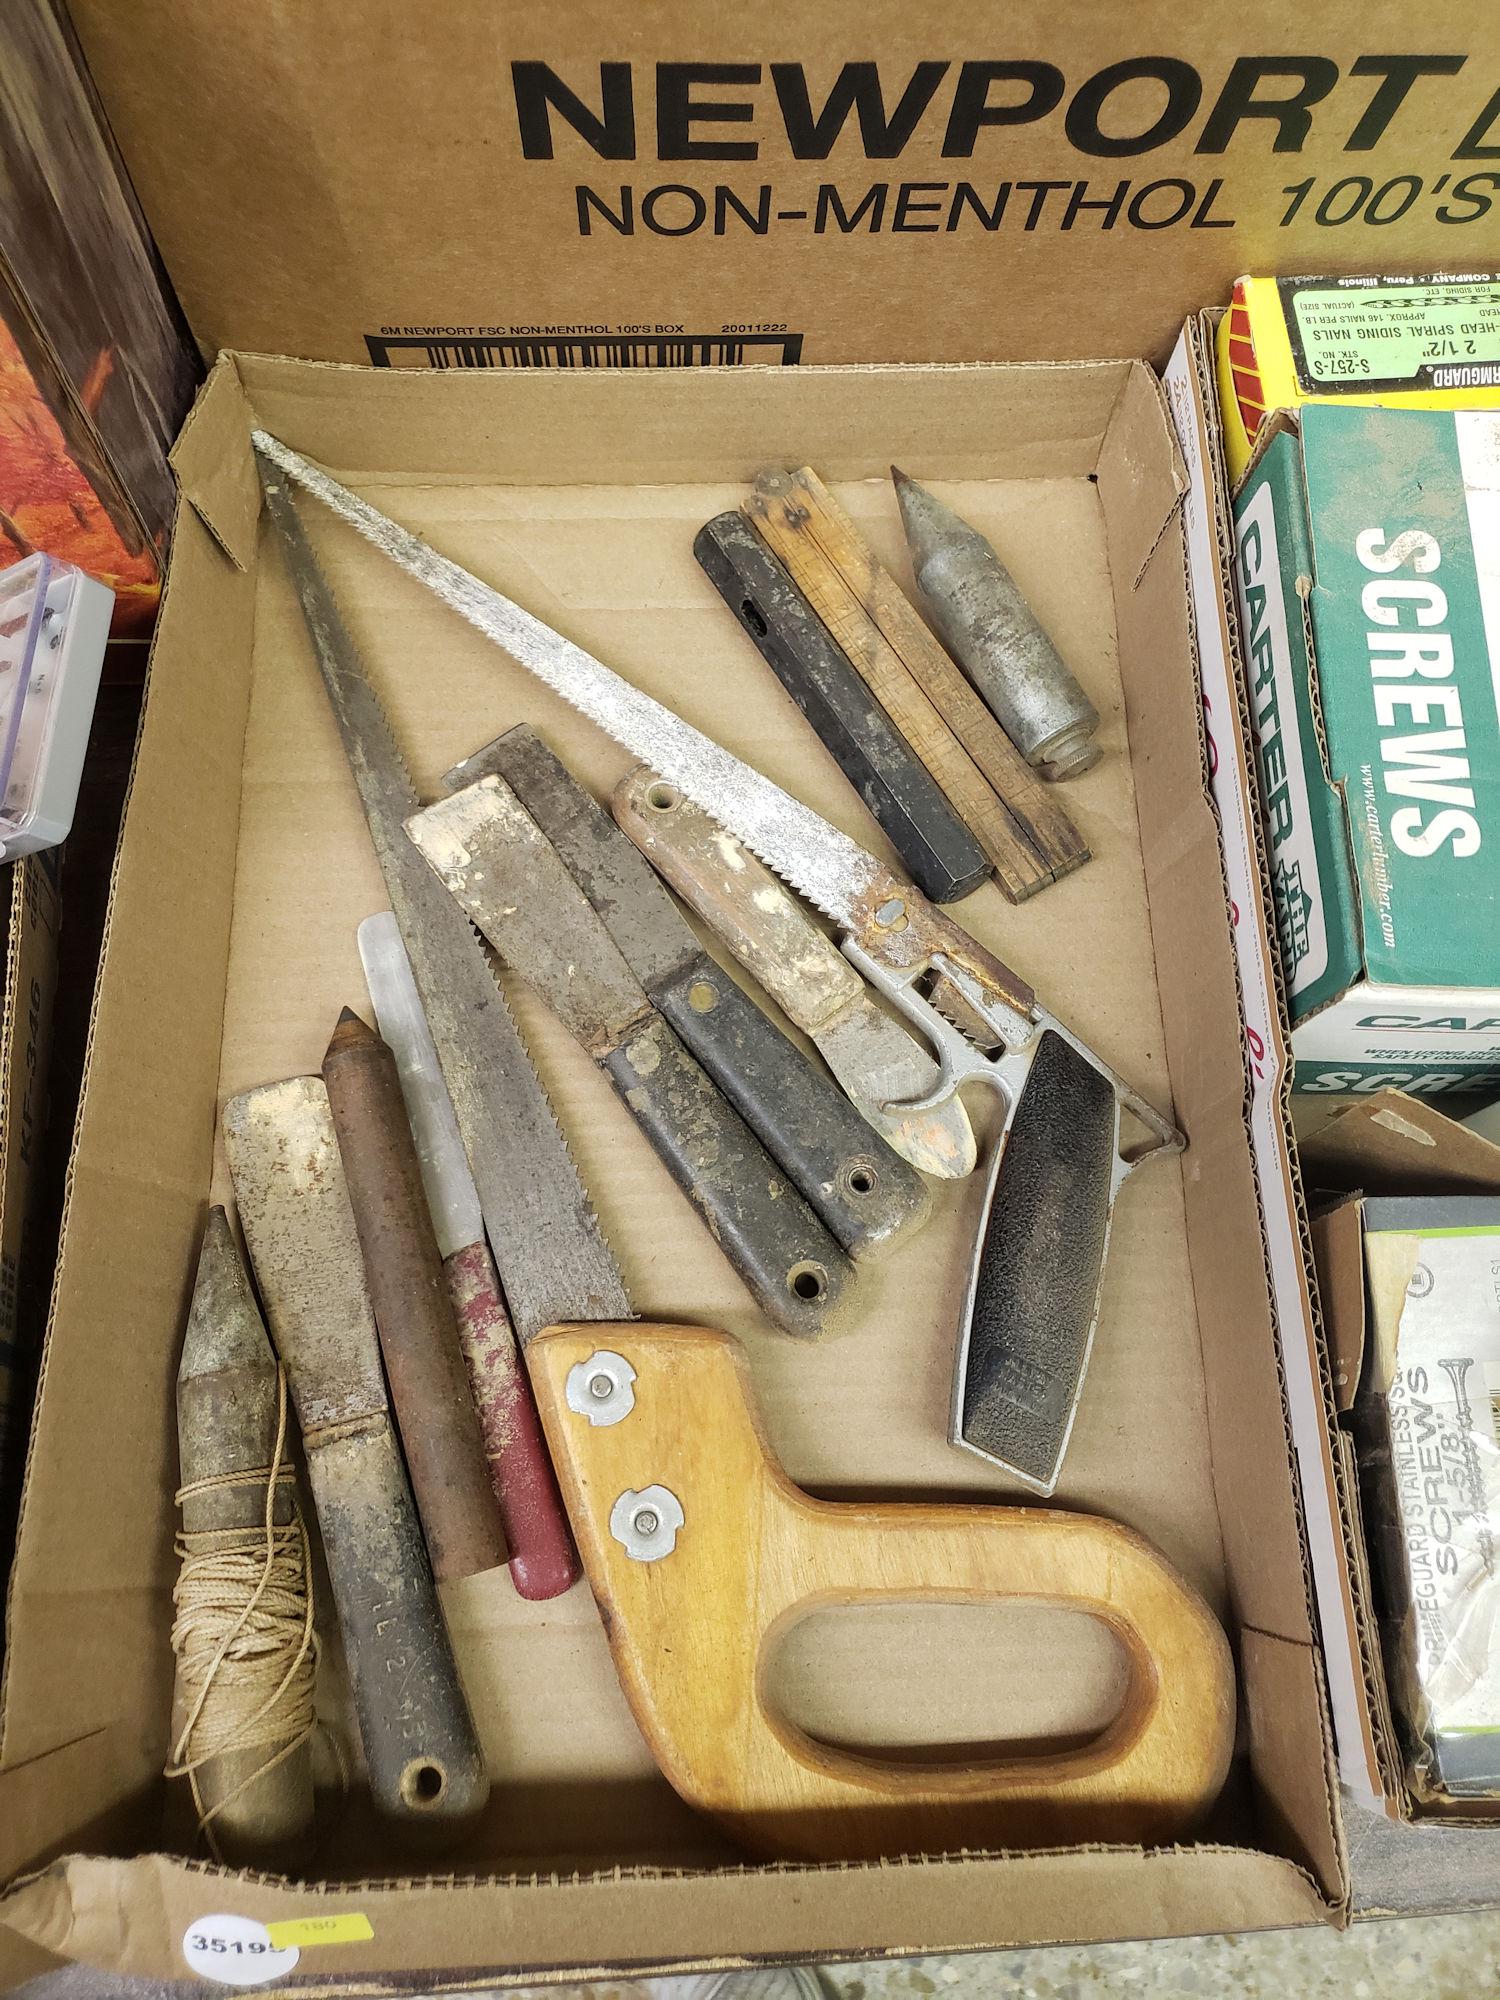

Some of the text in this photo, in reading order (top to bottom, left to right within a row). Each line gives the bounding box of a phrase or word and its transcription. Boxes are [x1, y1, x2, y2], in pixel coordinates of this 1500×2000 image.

[510, 55, 1468, 161] NEWPORT
[576, 172, 1500, 237] NON-MENTHOL 100'S
[1337, 275, 1379, 287] Illinois
[1300, 301, 1355, 311] (ACTUAL SIZE)
[1302, 312, 1426, 324] APPROX. 146 NAILS PER LB.
[380, 323, 789, 336] 6M NEWPORT FSC NON-MENTHOL 100'S BOX 20011222
[1312, 329, 1352, 341] NAILS
[1357, 326, 1403, 339] SIDING
[1406, 324, 1455, 337] SPIRAL
[1318, 350, 1359, 359] STK. NO.
[1422, 339, 1477, 357] 2 1/2"
[1315, 358, 1371, 375] S-257-S
[1240, 519, 1294, 851] CARTER
[1356, 527, 1482, 858] SCREWS
[1358, 763, 1396, 948] www.carterlumber.com
[1391, 1405, 1426, 1516] STAINLESS
[1407, 1366, 1458, 1576] SCREWS
[1405, 1520, 1447, 1666] PRIMEGUARD
